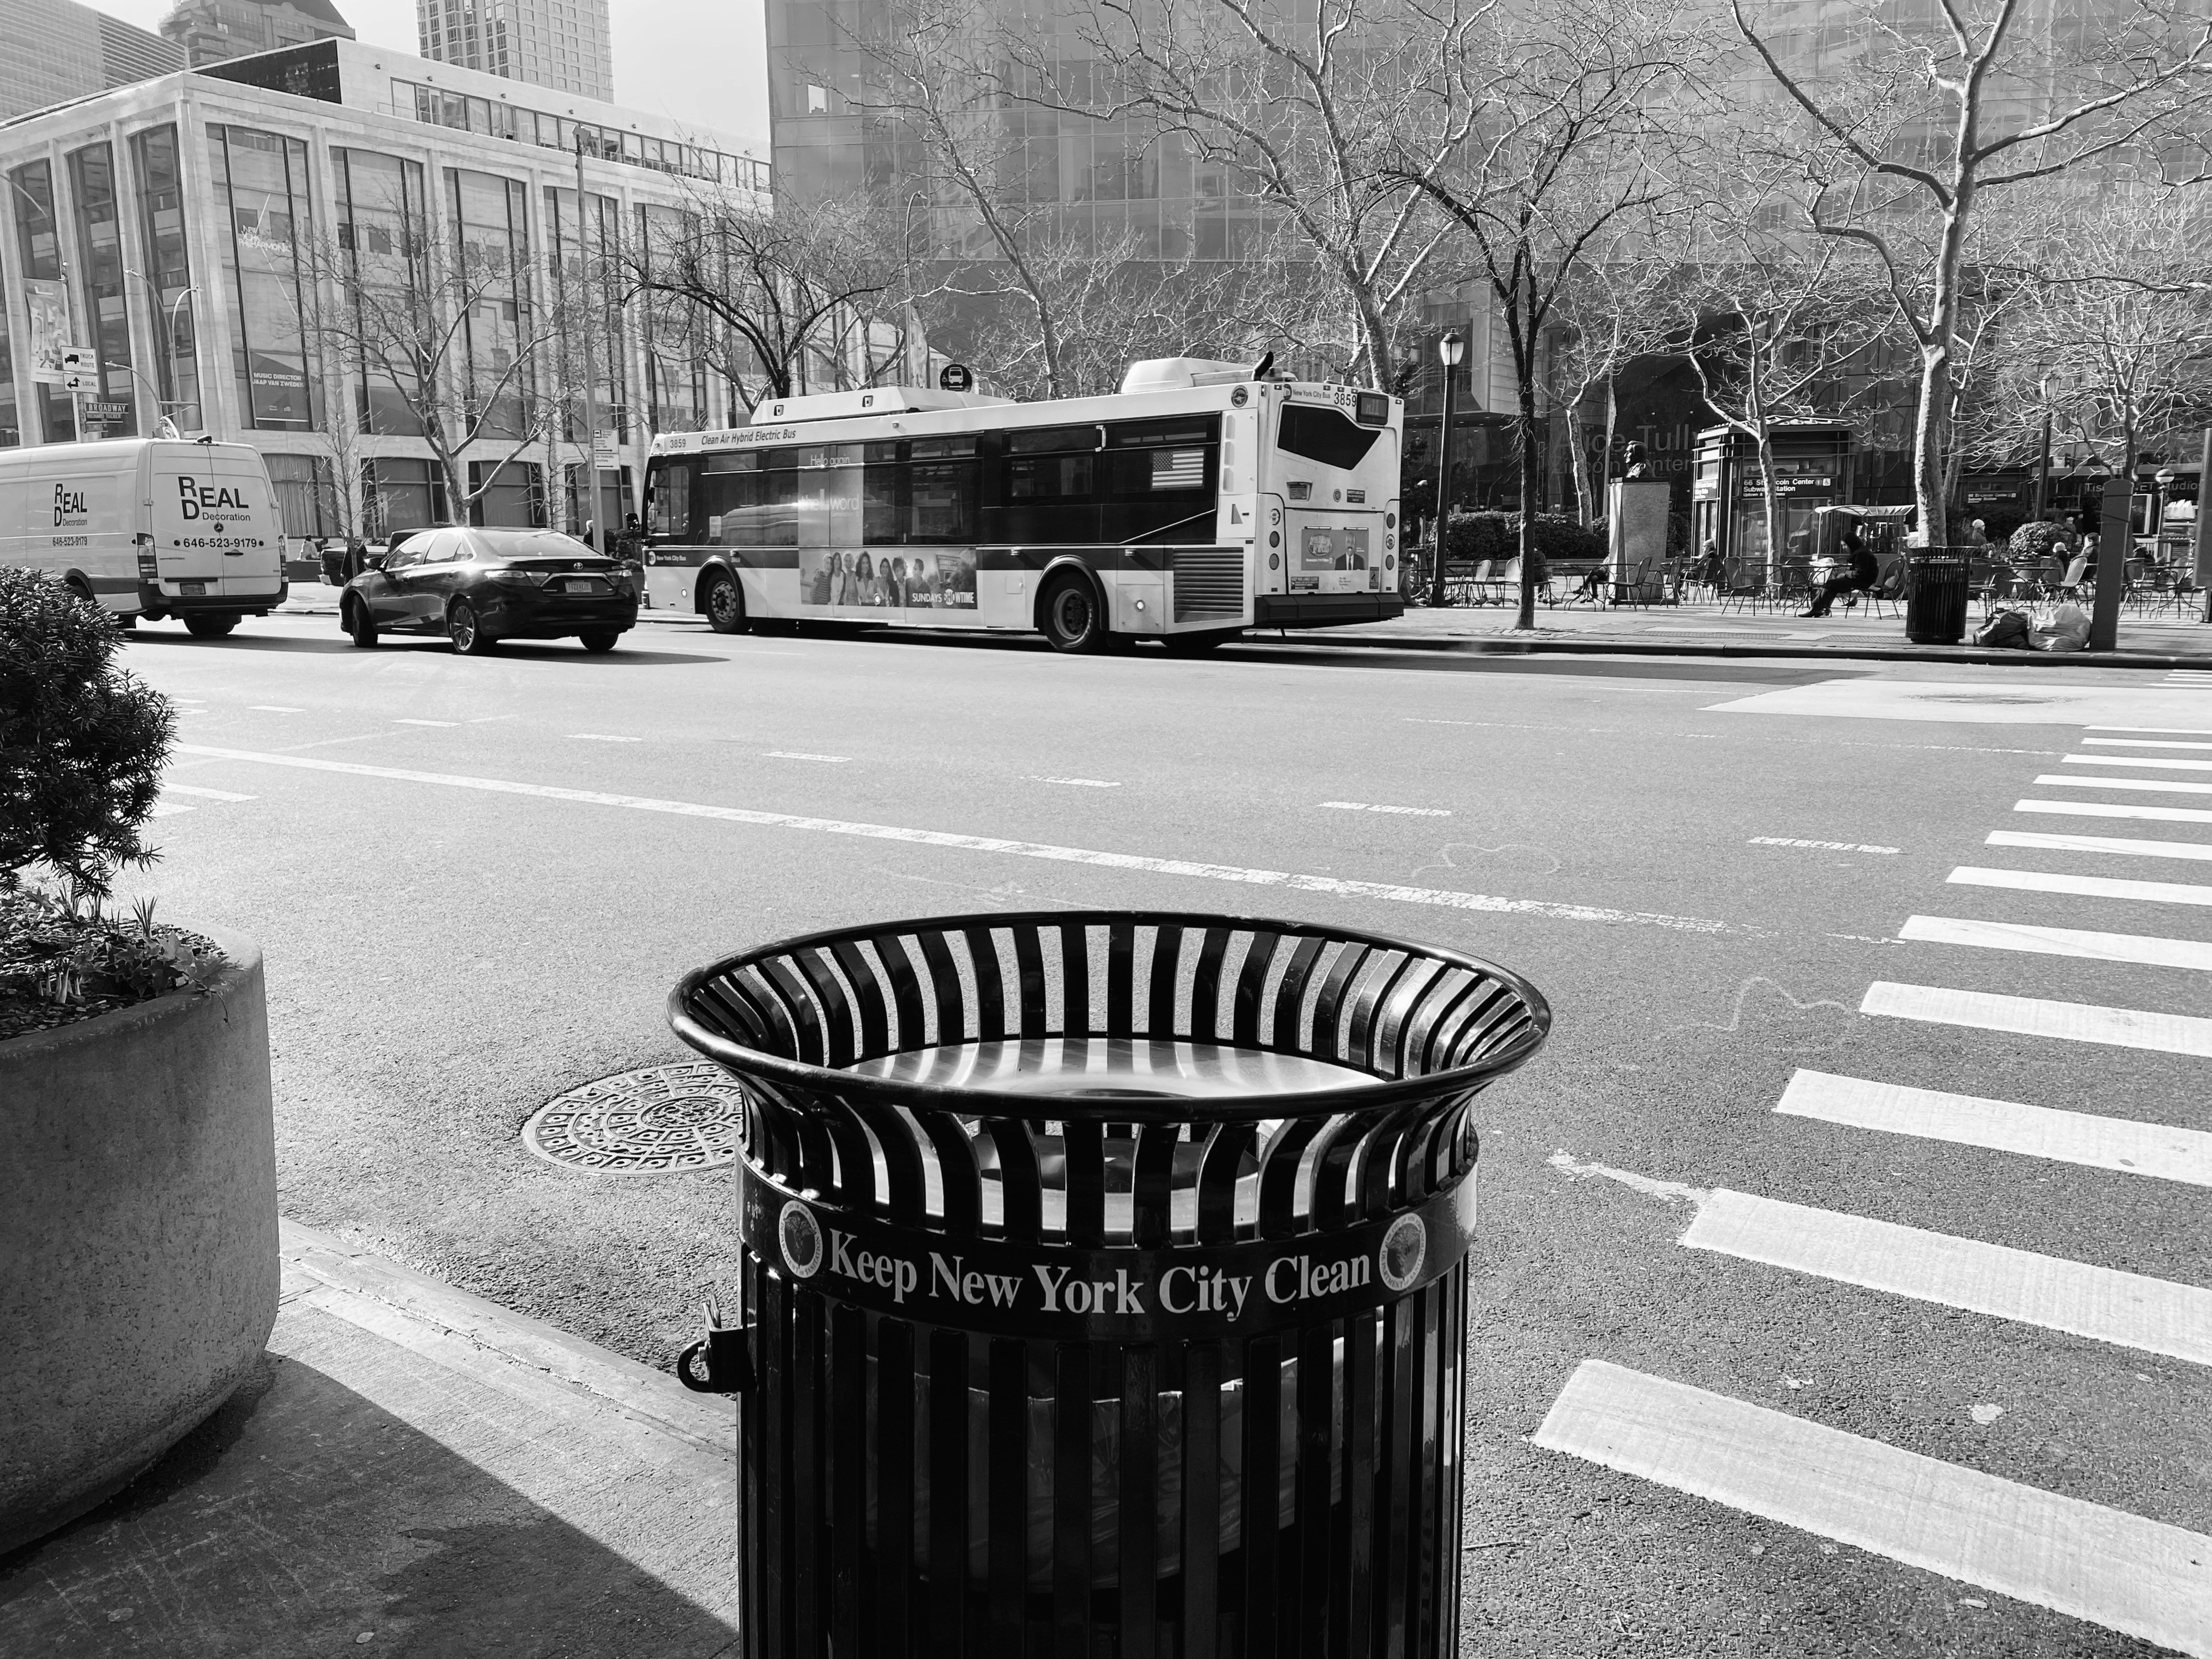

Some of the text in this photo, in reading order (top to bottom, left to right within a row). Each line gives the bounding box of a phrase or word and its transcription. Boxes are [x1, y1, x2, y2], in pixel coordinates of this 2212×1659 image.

[1334, 392, 1356, 407] 3859
[88, 403, 126, 413] BROADWAY
[670, 438, 686, 448] 3859
[702, 429, 796, 445] Clean Air Hybrid Electric Bus
[1552, 426, 1626, 453] Aice
[1626, 457, 1692, 472] nter
[2085, 482, 2105, 493] Tis
[830, 493, 860, 510] word
[202, 512, 251, 521] Decoration
[53, 537, 87, 546] 646-523-9179
[183, 538, 257, 548] 646-523-9179
[912, 588, 975, 606] SUNDAYS SHOWTIME
[830, 1228, 1371, 1322] Keep New York City Clean
